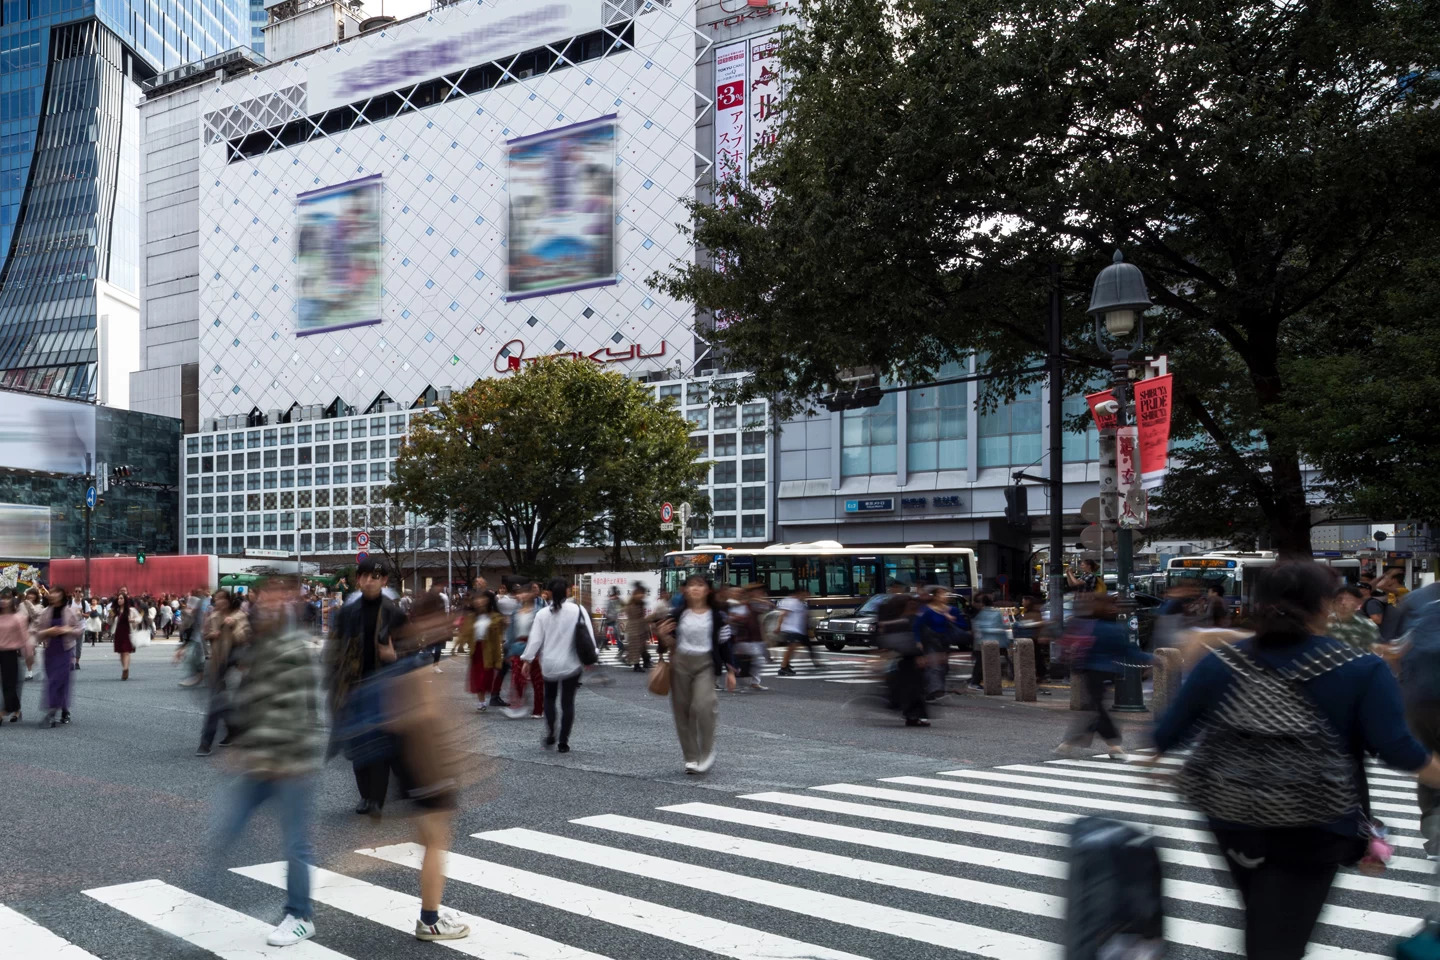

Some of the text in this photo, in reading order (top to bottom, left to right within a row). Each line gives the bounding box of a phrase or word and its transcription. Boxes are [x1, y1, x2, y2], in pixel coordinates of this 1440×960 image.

[718, 86, 744, 105] +3%
[1140, 386, 1167, 400] SHIBUYA
[1140, 396, 1167, 412] PRIDE
